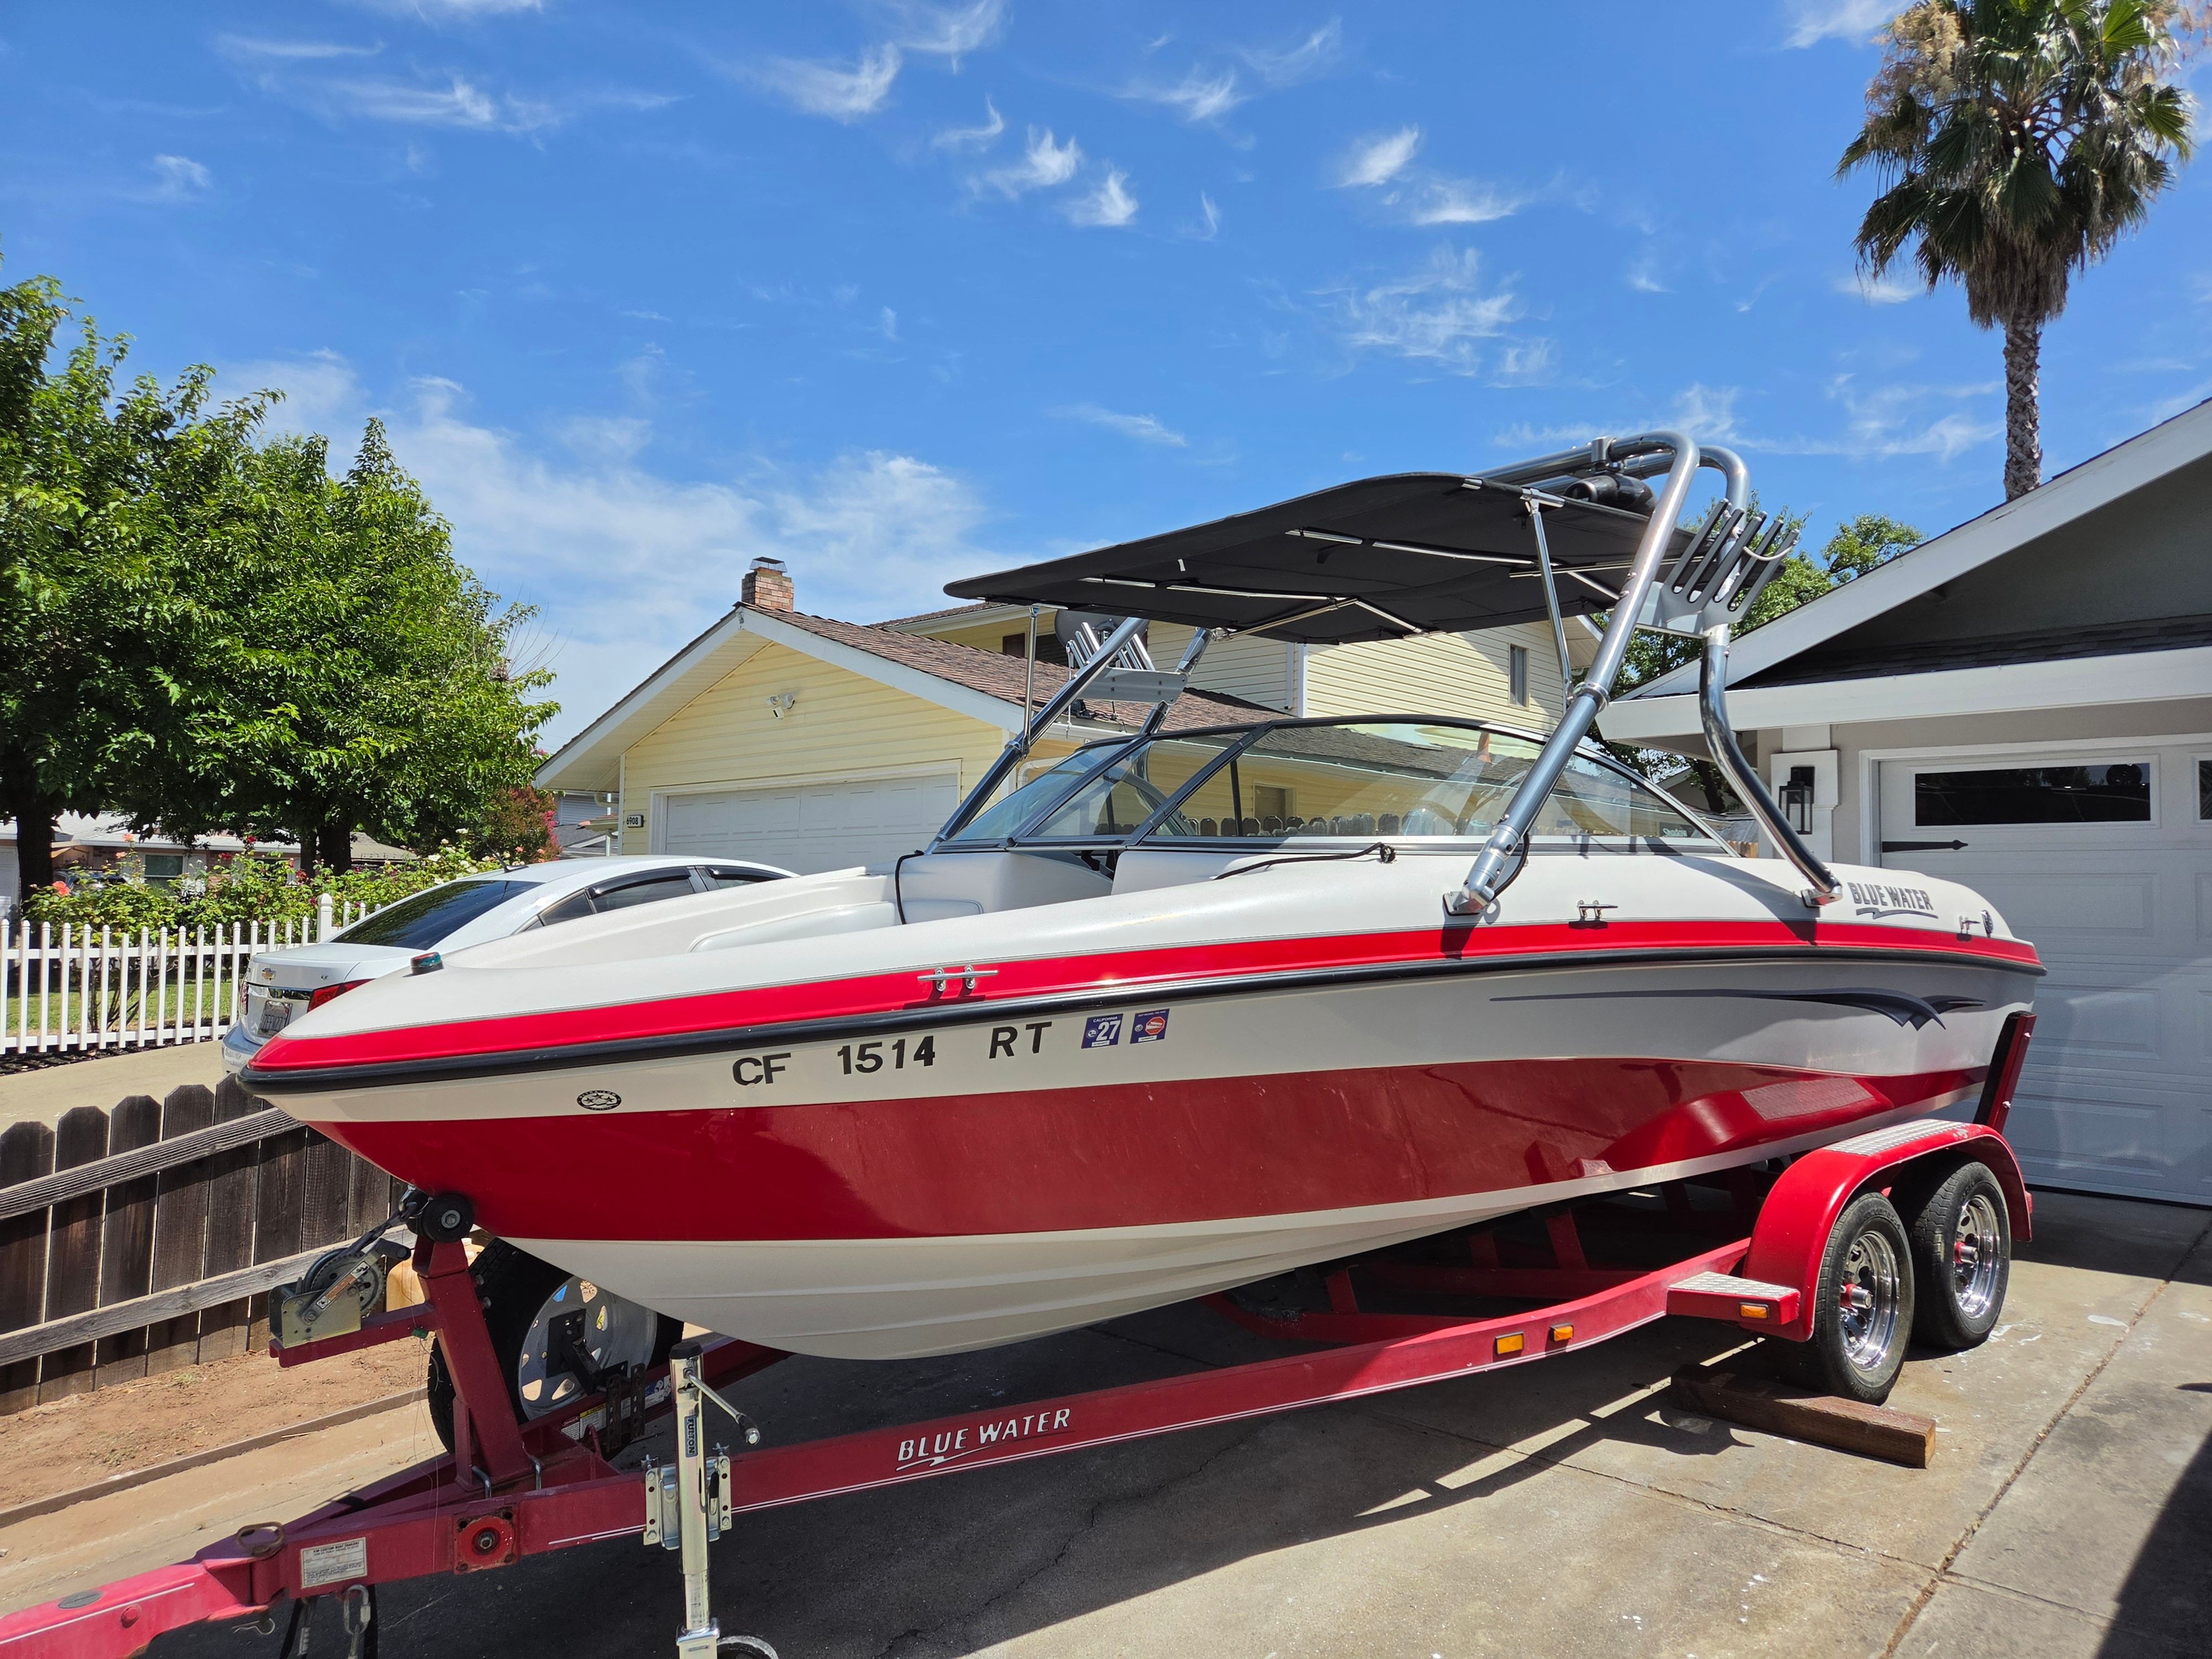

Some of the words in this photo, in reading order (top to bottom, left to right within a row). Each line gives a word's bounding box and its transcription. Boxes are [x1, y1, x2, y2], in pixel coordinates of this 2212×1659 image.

[1847, 882, 1888, 906] BLUE
[1884, 885, 1934, 910] WATER
[1095, 1020, 1121, 1041] 27
[732, 1052, 791, 1086] CF
[837, 1035, 936, 1075] 1514
[989, 1021, 1052, 1059] RT
[687, 1418, 696, 1454] FULTON
[898, 1428, 969, 1461] BLUE
[979, 1408, 1071, 1444] WATER
